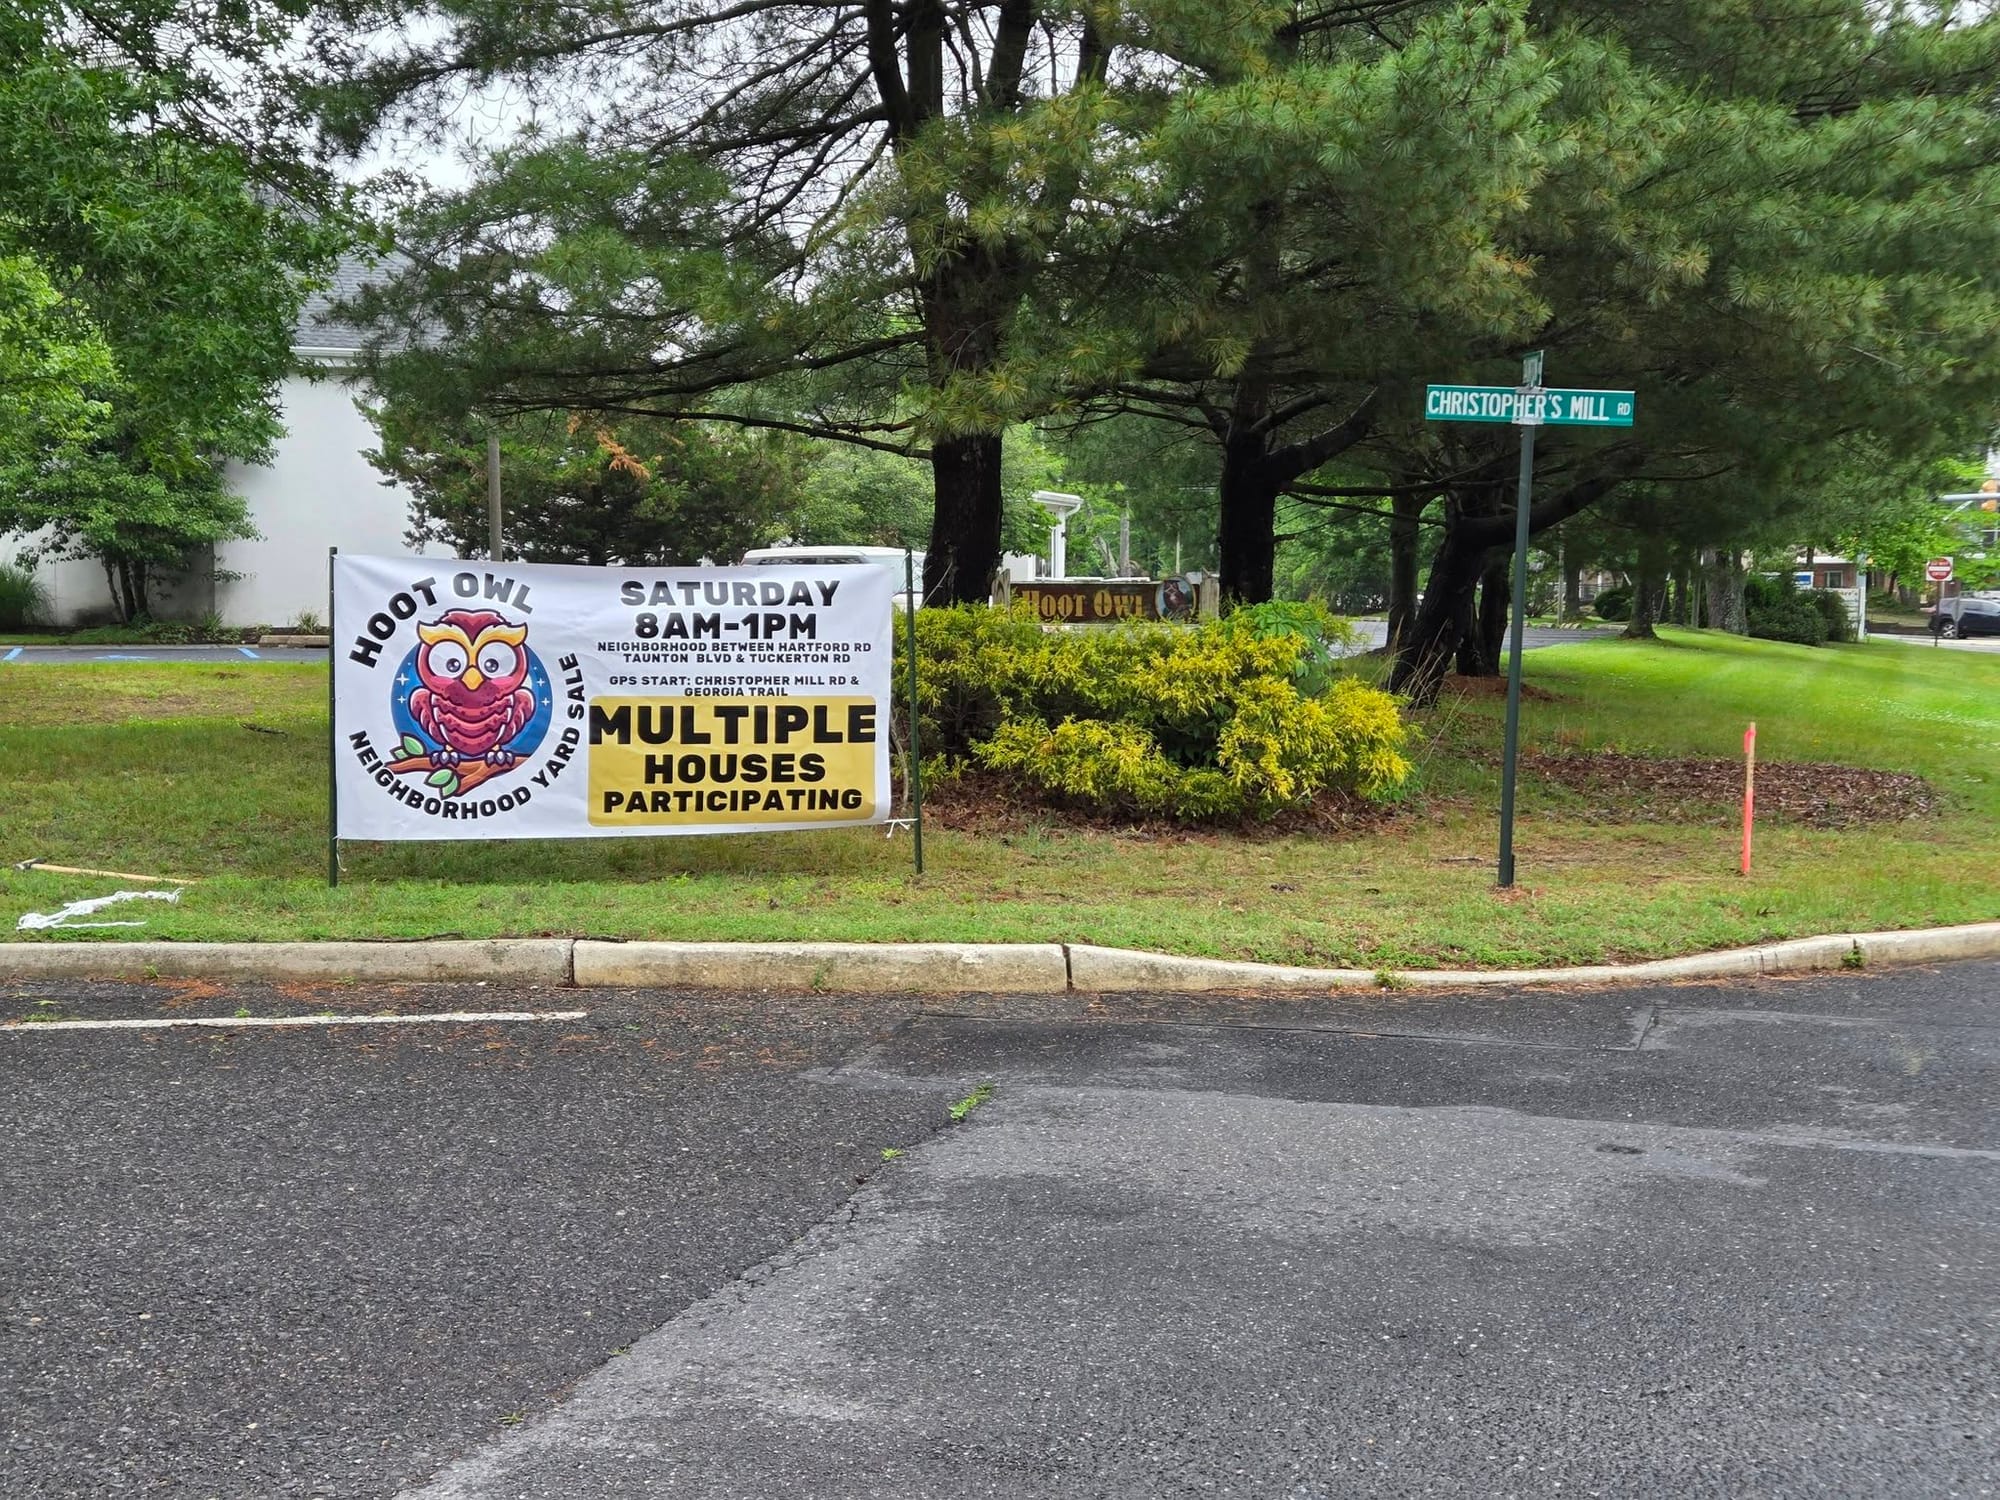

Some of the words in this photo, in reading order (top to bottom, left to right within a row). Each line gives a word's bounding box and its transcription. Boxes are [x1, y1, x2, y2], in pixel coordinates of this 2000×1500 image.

[1428, 391, 1563, 419] CHRISTOPHER'S
[1570, 396, 1610, 421] MILL
[1617, 402, 1631, 416] RD
[620, 580, 840, 606] SATURDAY
[349, 576, 438, 669] HOOT
[453, 571, 534, 615] OWL
[635, 612, 817, 640] 8AM-1PM
[598, 641, 707, 652] NEIGHBORHOOD
[712, 642, 774, 652] BETWEEN
[778, 642, 850, 652] HARTFORD
[854, 642, 872, 652] RD
[623, 653, 689, 663] TAUNTON
[696, 653, 732, 663] BLVD
[736, 653, 745, 663] &
[749, 653, 830, 663] TUCKERTON
[833, 653, 851, 663] RD
[609, 676, 637, 686] GPS
[641, 676, 691, 686] START:
[694, 675, 790, 686] CHRISTOPHER
[794, 675, 825, 685] MILL
[829, 675, 847, 685] RD
[850, 675, 860, 685] &
[684, 687, 744, 697] GEORGIA
[748, 687, 789, 697] TRAIL
[349, 730, 531, 820] NEIGHBORHOOD
[530, 727, 581, 789] YARD
[558, 652, 586, 721] SALE
[589, 704, 877, 745] MULTIPLE
[644, 753, 826, 785] HOUSES
[603, 788, 863, 813] PARTICIPATING
